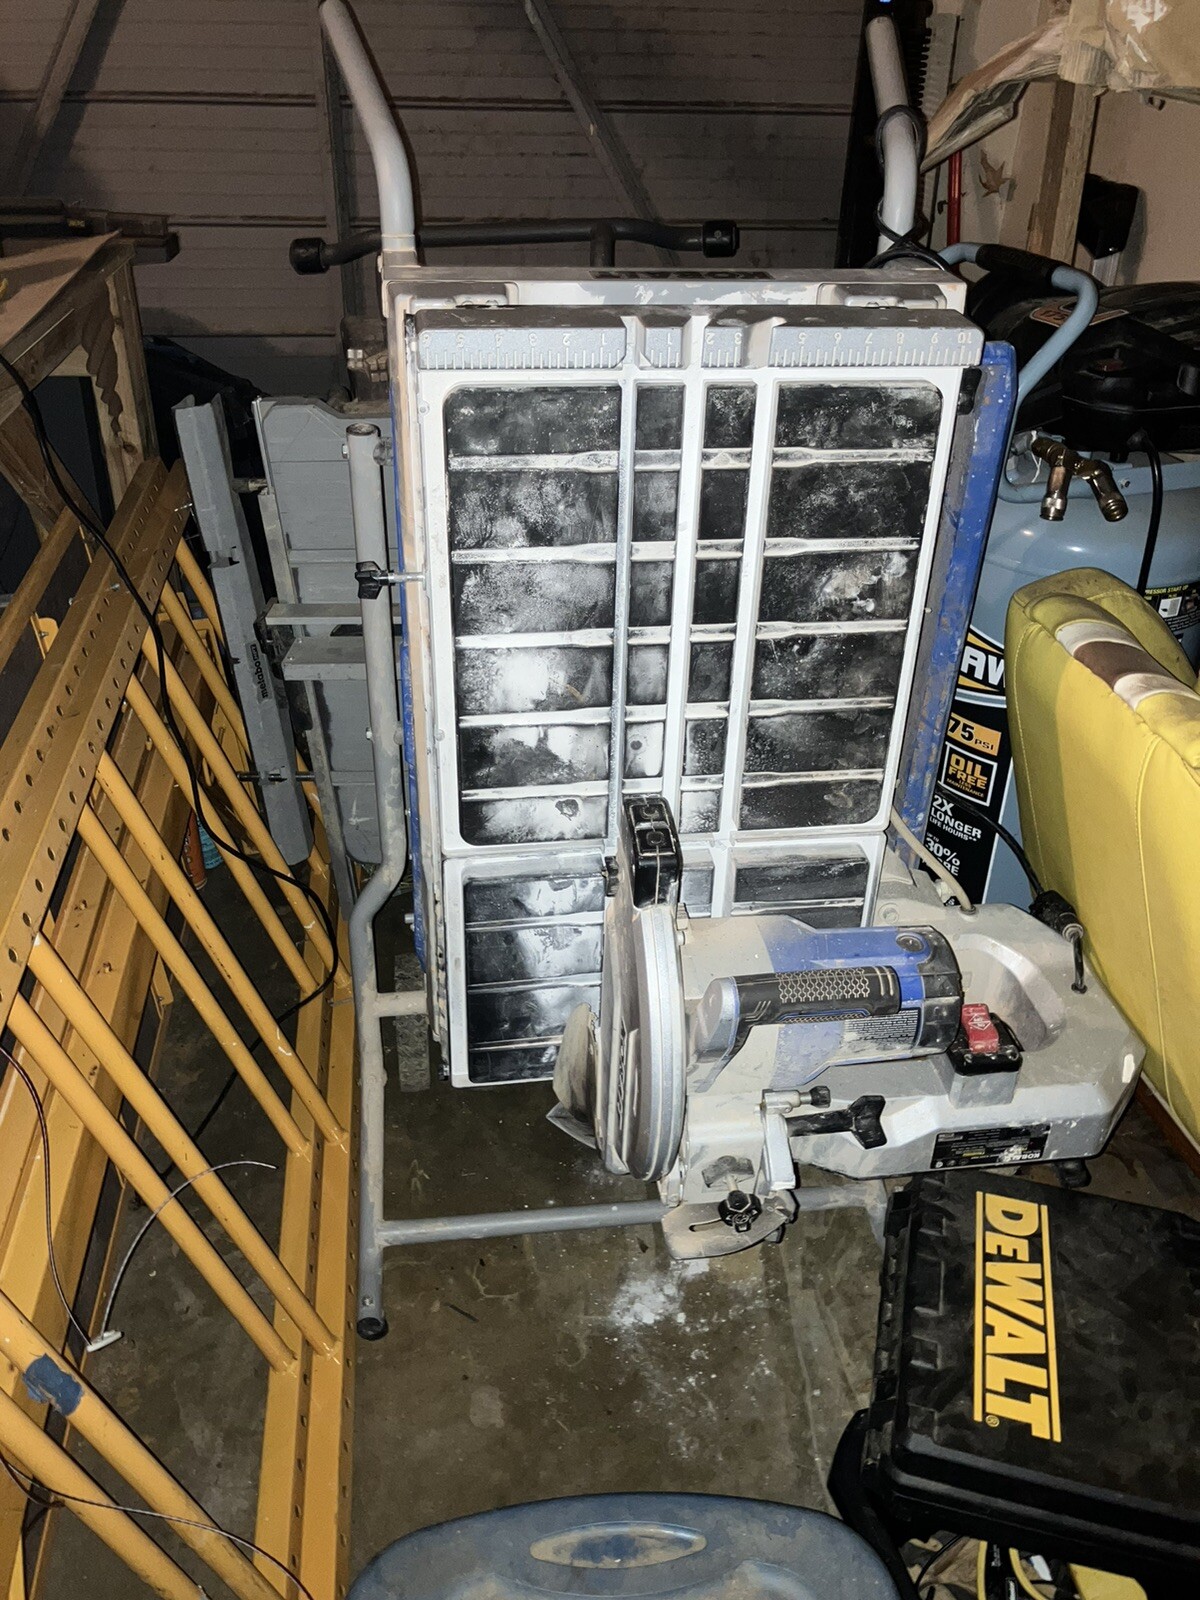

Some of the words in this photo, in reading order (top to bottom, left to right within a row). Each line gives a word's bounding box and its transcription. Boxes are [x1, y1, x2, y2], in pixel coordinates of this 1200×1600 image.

[563, 333, 571, 345] 2
[706, 332, 715, 345] 2
[734, 332, 743, 345] 3
[798, 333, 807, 344] 5
[865, 332, 873, 344] 7
[254, 661, 268, 698] metabo
[950, 753, 988, 780] OIL
[946, 778, 985, 798] MAINTENANCE
[948, 766, 988, 790] FREE
[932, 795, 954, 816] 2X
[929, 816, 942, 828] LIFE
[930, 807, 982, 839] LONGER
[925, 837, 960, 866] 30%
[985, 1193, 1050, 1440] DEWALT
